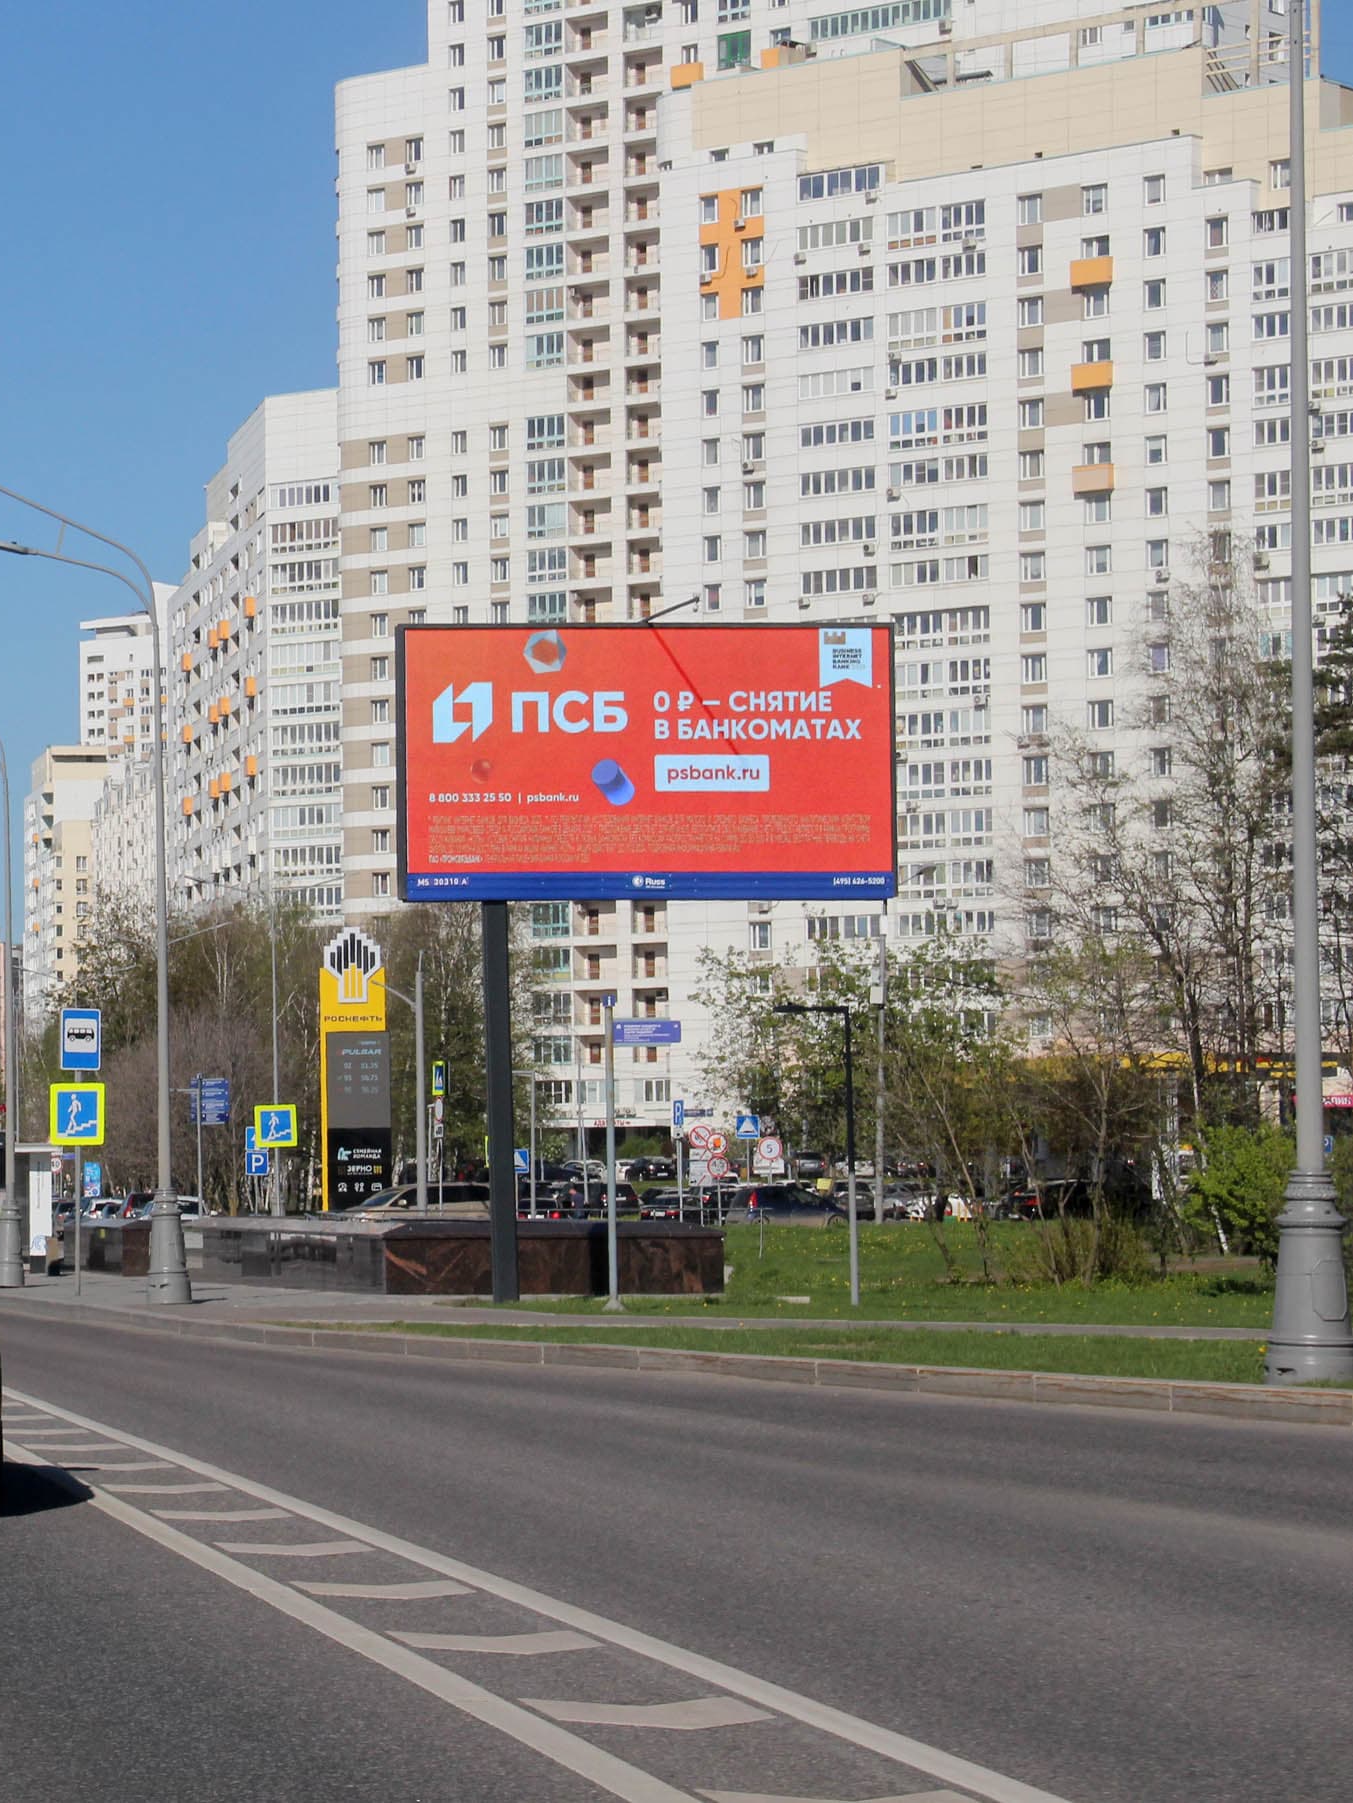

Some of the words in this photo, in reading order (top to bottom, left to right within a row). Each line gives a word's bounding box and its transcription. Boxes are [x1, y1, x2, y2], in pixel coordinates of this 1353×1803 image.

[728, 690, 832, 712] СНЯТИЕ
[511, 691, 628, 733] ПСБ
[654, 718, 670, 740] В
[678, 717, 862, 741] БАНКОМАТАХ
[666, 765, 760, 785] psbank.ru
[429, 793, 436, 803] 8
[438, 793, 459, 803] 800
[462, 793, 481, 803] 333
[483, 793, 496, 803] 25
[498, 793, 512, 803] 50
[527, 793, 580, 806] psbank.ru
[645, 877, 666, 885] Russ
